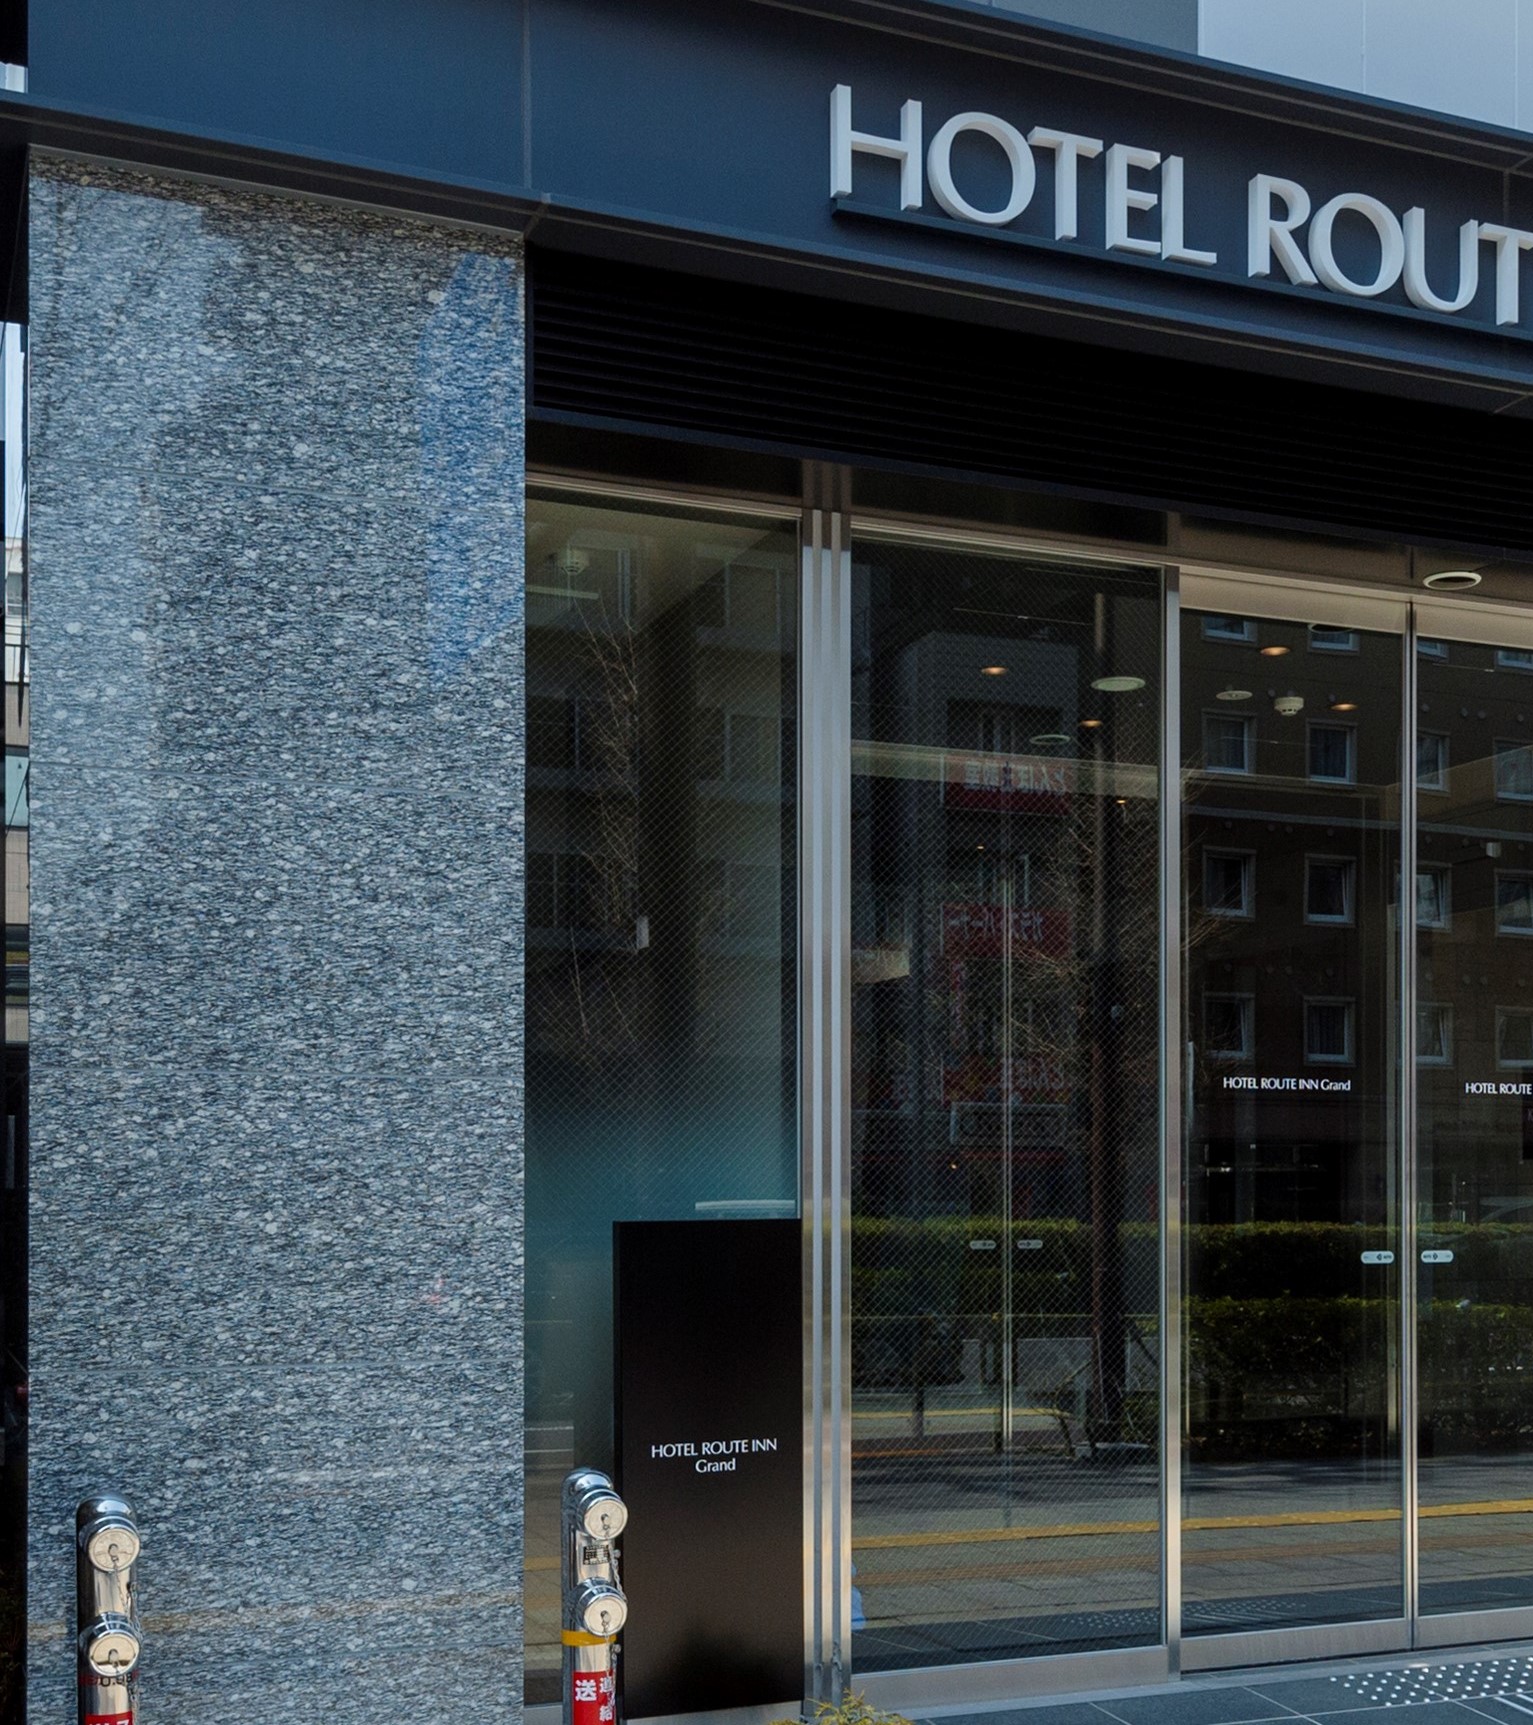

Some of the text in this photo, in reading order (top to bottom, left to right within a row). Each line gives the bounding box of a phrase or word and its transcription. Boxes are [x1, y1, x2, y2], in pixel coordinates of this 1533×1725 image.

[829, 83, 1217, 266] HOTEL
[1223, 1076, 1351, 1092] HOTEL ROUTE INN Grand
[1465, 1082, 1498, 1095] HOTEL
[1499, 1082, 1532, 1096] ROUTE
[651, 1438, 777, 1458] HOTEL ROUTE INN
[695, 1458, 736, 1473] Grand
[575, 1679, 597, 1701] 送
